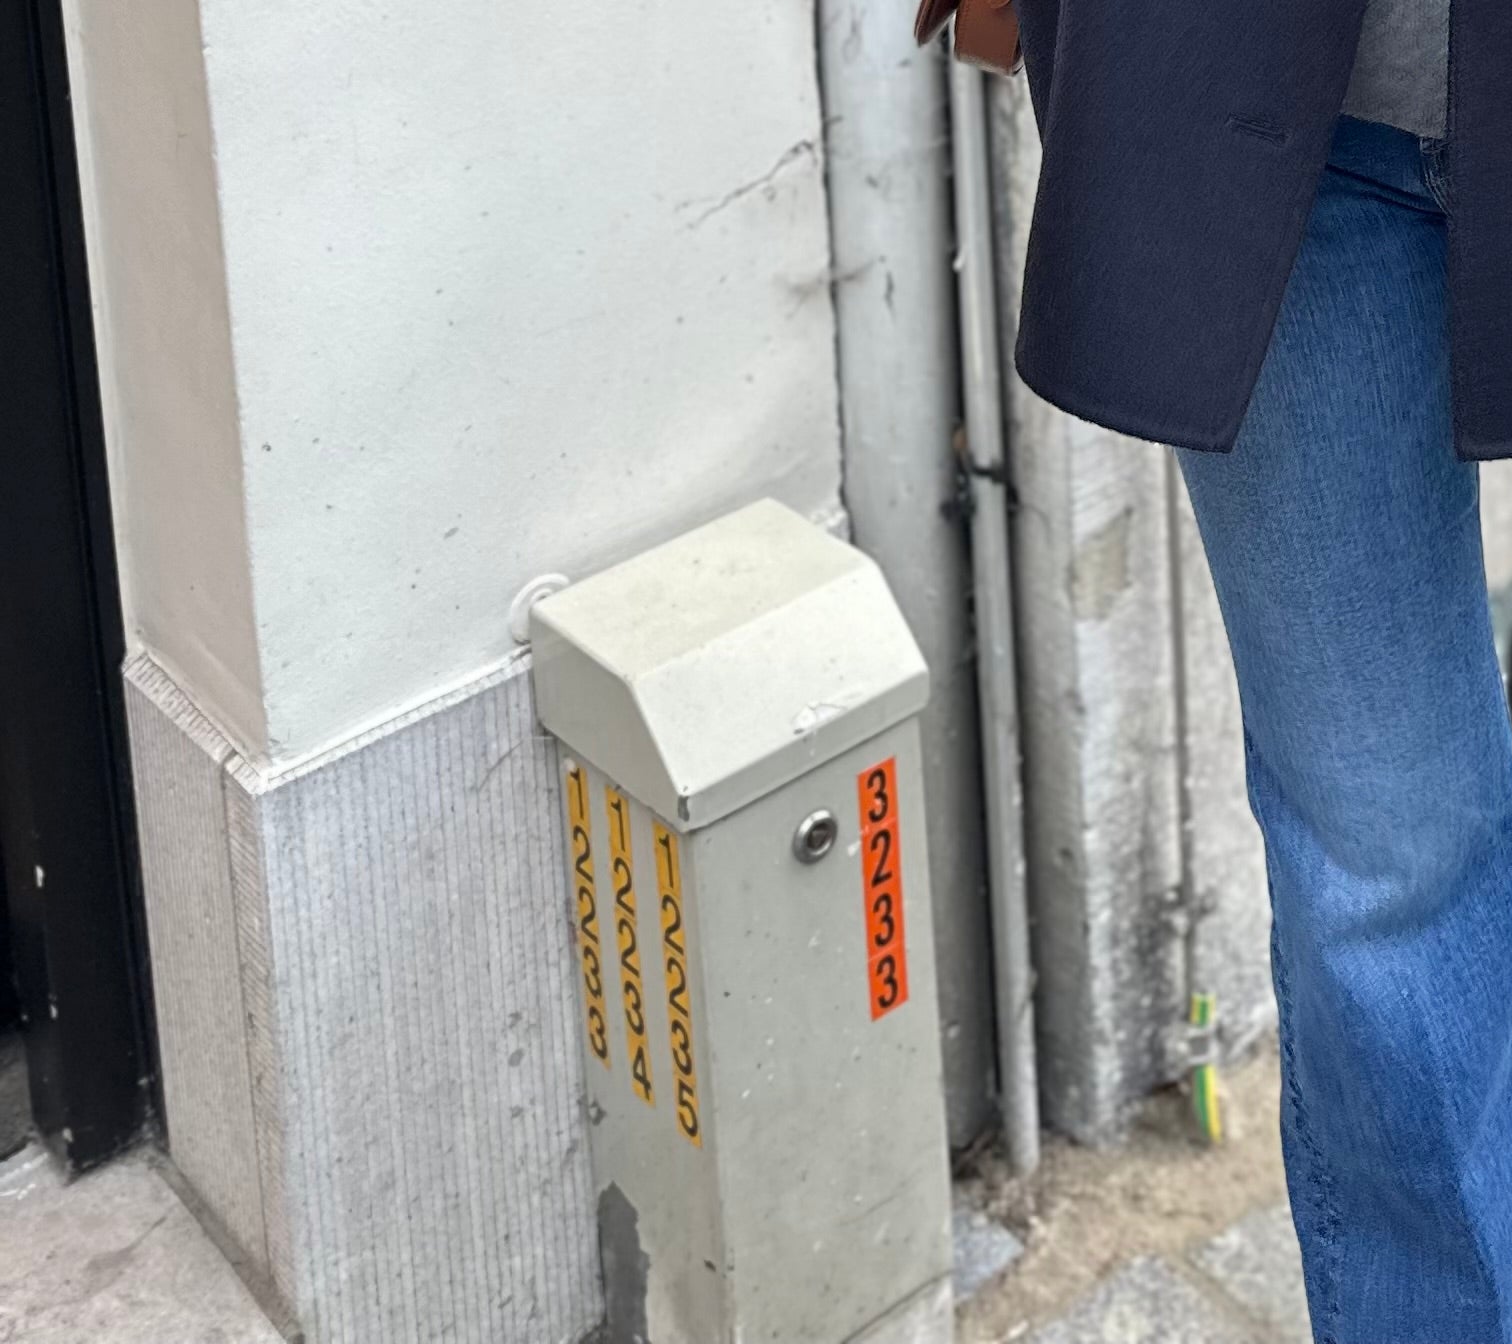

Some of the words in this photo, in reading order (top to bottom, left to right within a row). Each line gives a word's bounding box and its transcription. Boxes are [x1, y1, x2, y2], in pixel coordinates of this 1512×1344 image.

[570, 767, 608, 1060] 12233
[610, 798, 652, 1101] 12234
[659, 834, 699, 1137] 12235
[867, 768, 899, 1009] 3233
